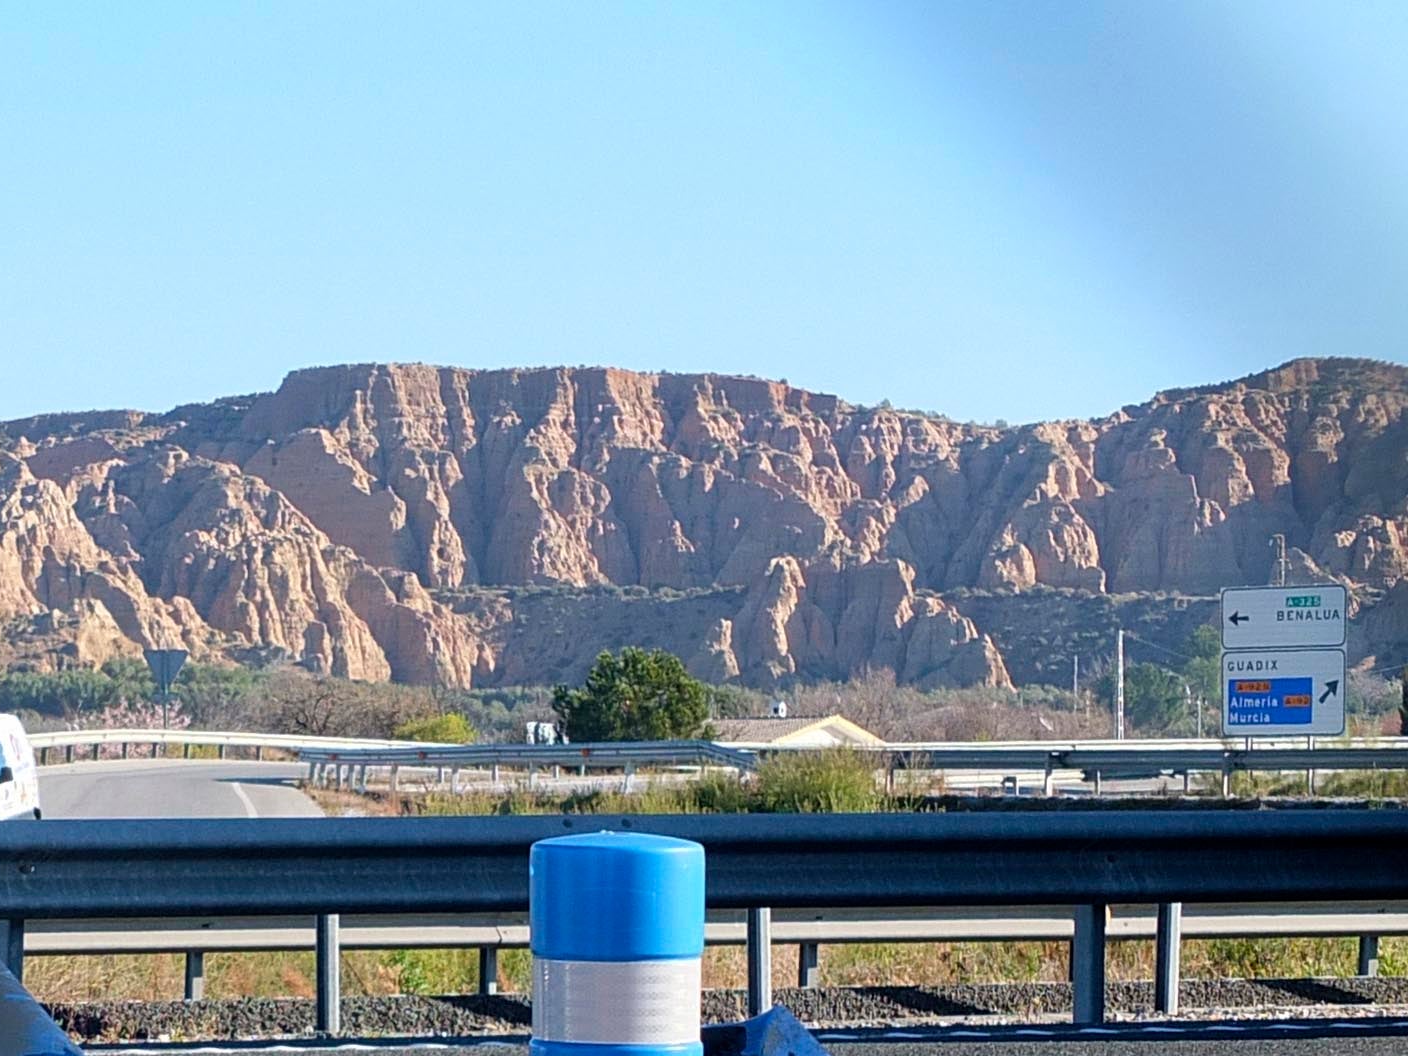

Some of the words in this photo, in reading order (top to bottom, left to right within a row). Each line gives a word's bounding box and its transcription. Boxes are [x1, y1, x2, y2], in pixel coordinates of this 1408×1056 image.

[1277, 609, 1340, 621] BENALUA
[1227, 660, 1278, 672] GUADIX
[1229, 712, 1270, 723] Murcia
